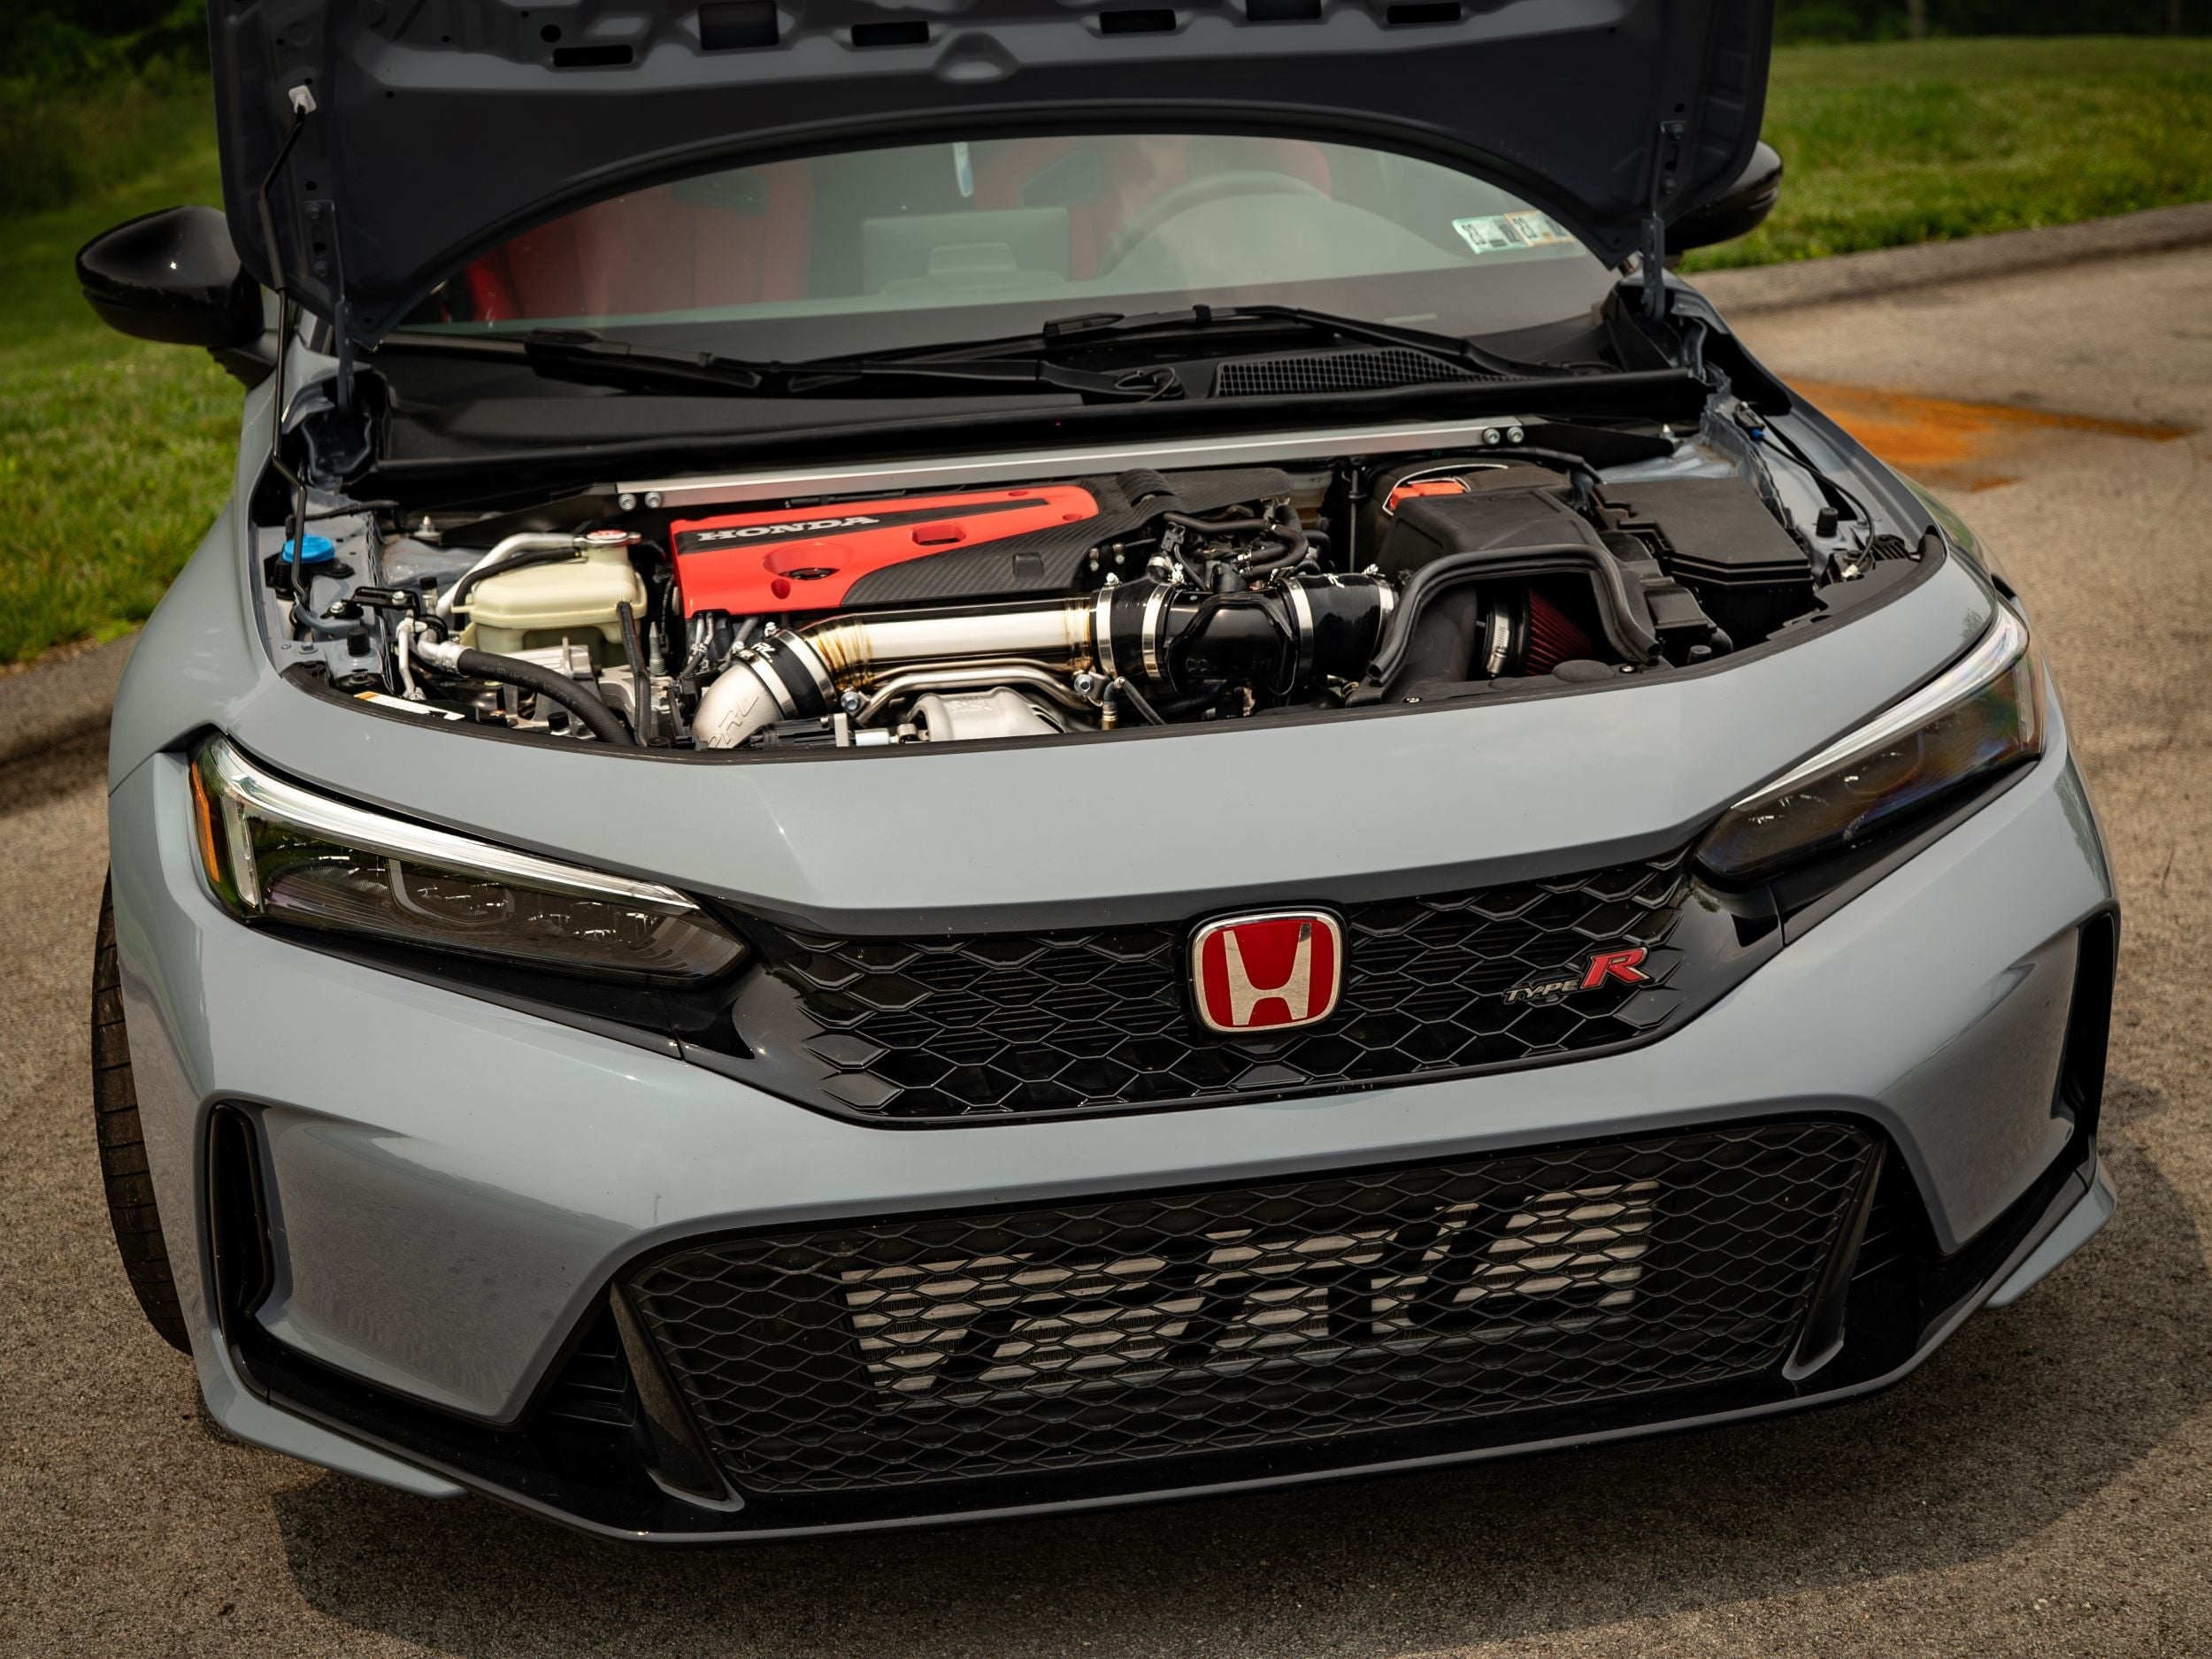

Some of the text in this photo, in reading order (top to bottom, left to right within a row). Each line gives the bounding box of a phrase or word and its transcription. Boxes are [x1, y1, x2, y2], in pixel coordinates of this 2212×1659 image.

[697, 516, 880, 541] HONDA
[1505, 947, 1651, 1002] TYPE R
